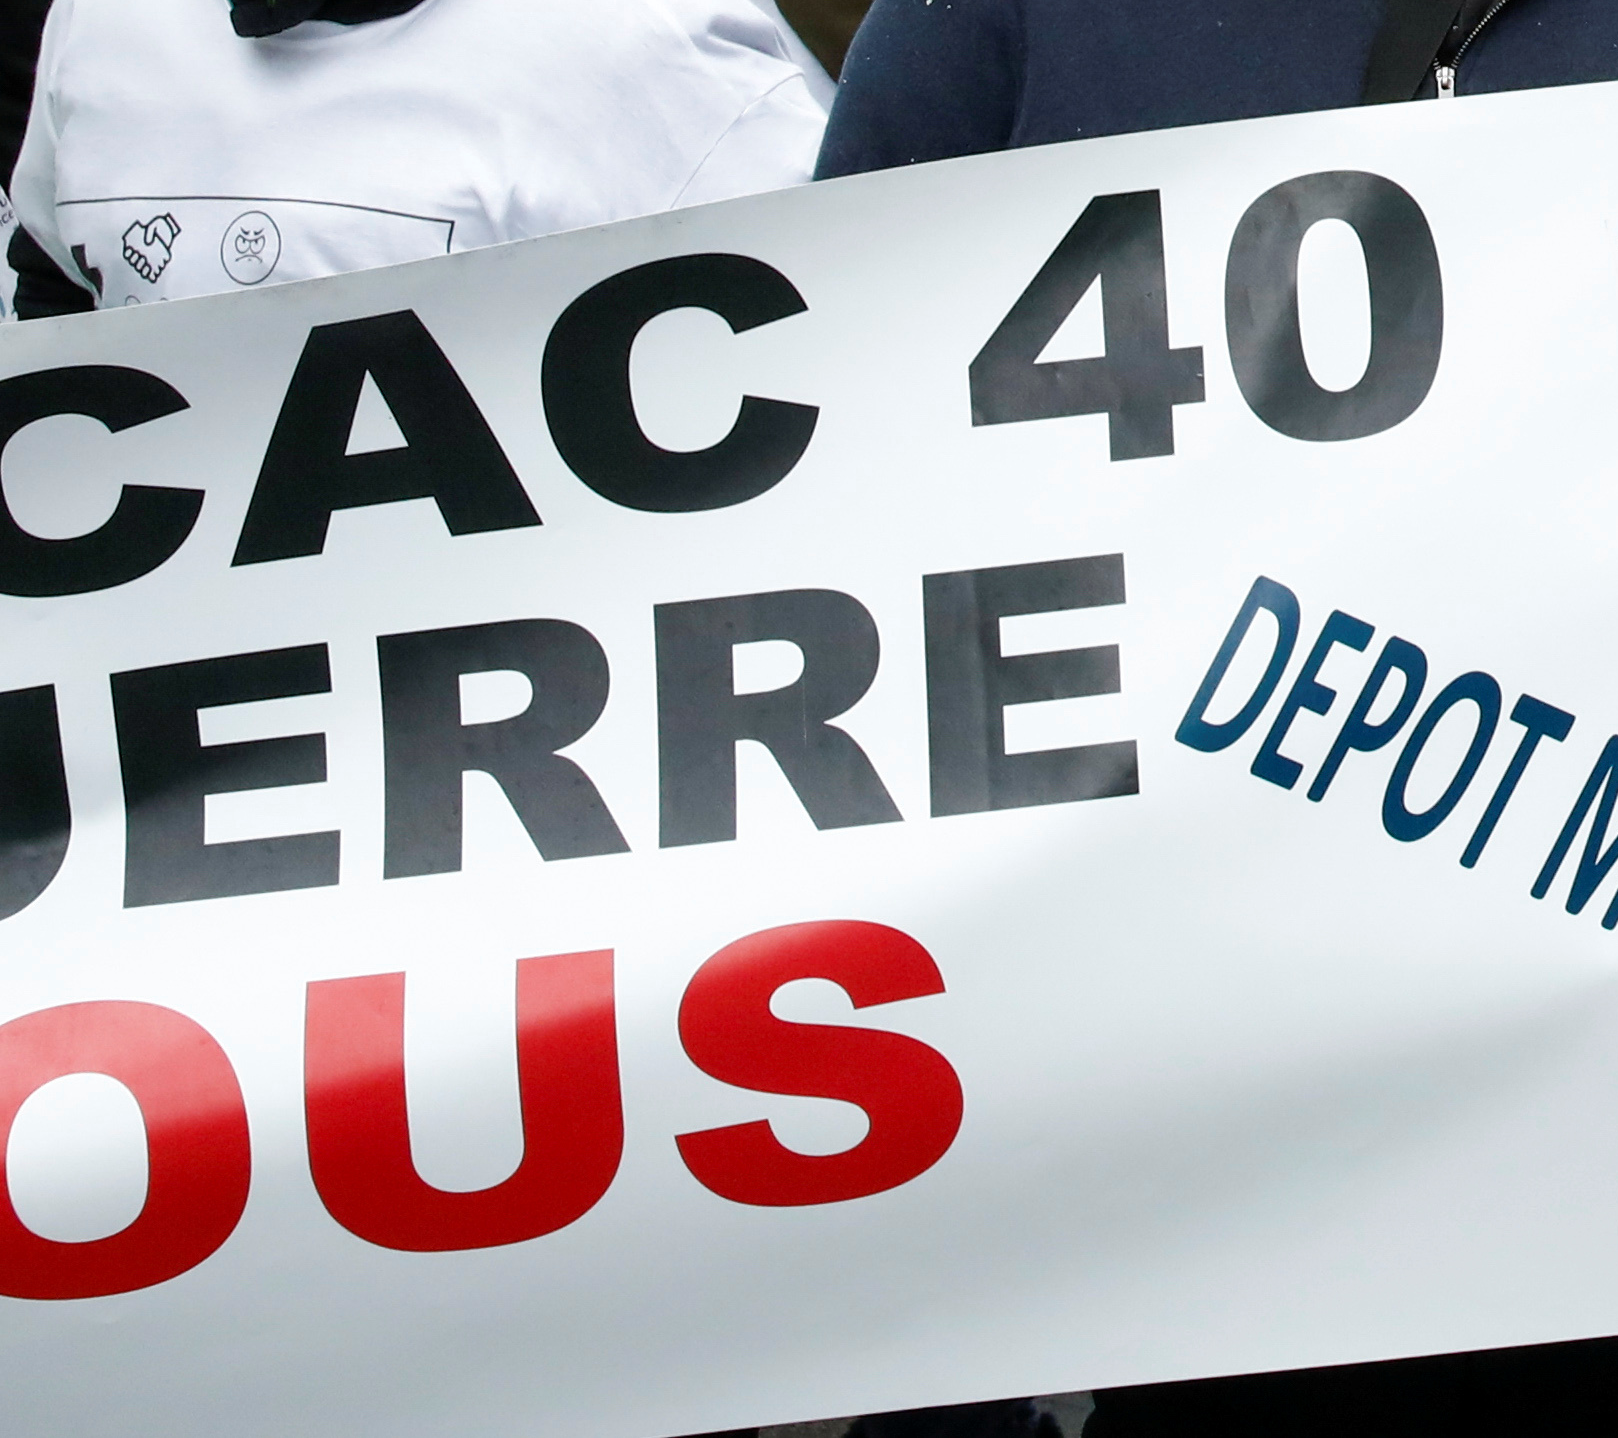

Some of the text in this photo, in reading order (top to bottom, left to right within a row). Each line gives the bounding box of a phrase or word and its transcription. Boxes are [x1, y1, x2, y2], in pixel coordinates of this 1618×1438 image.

[0, 252, 820, 598] CAC
[968, 169, 1444, 462] 40
[1175, 575, 1576, 870] DEPOT
